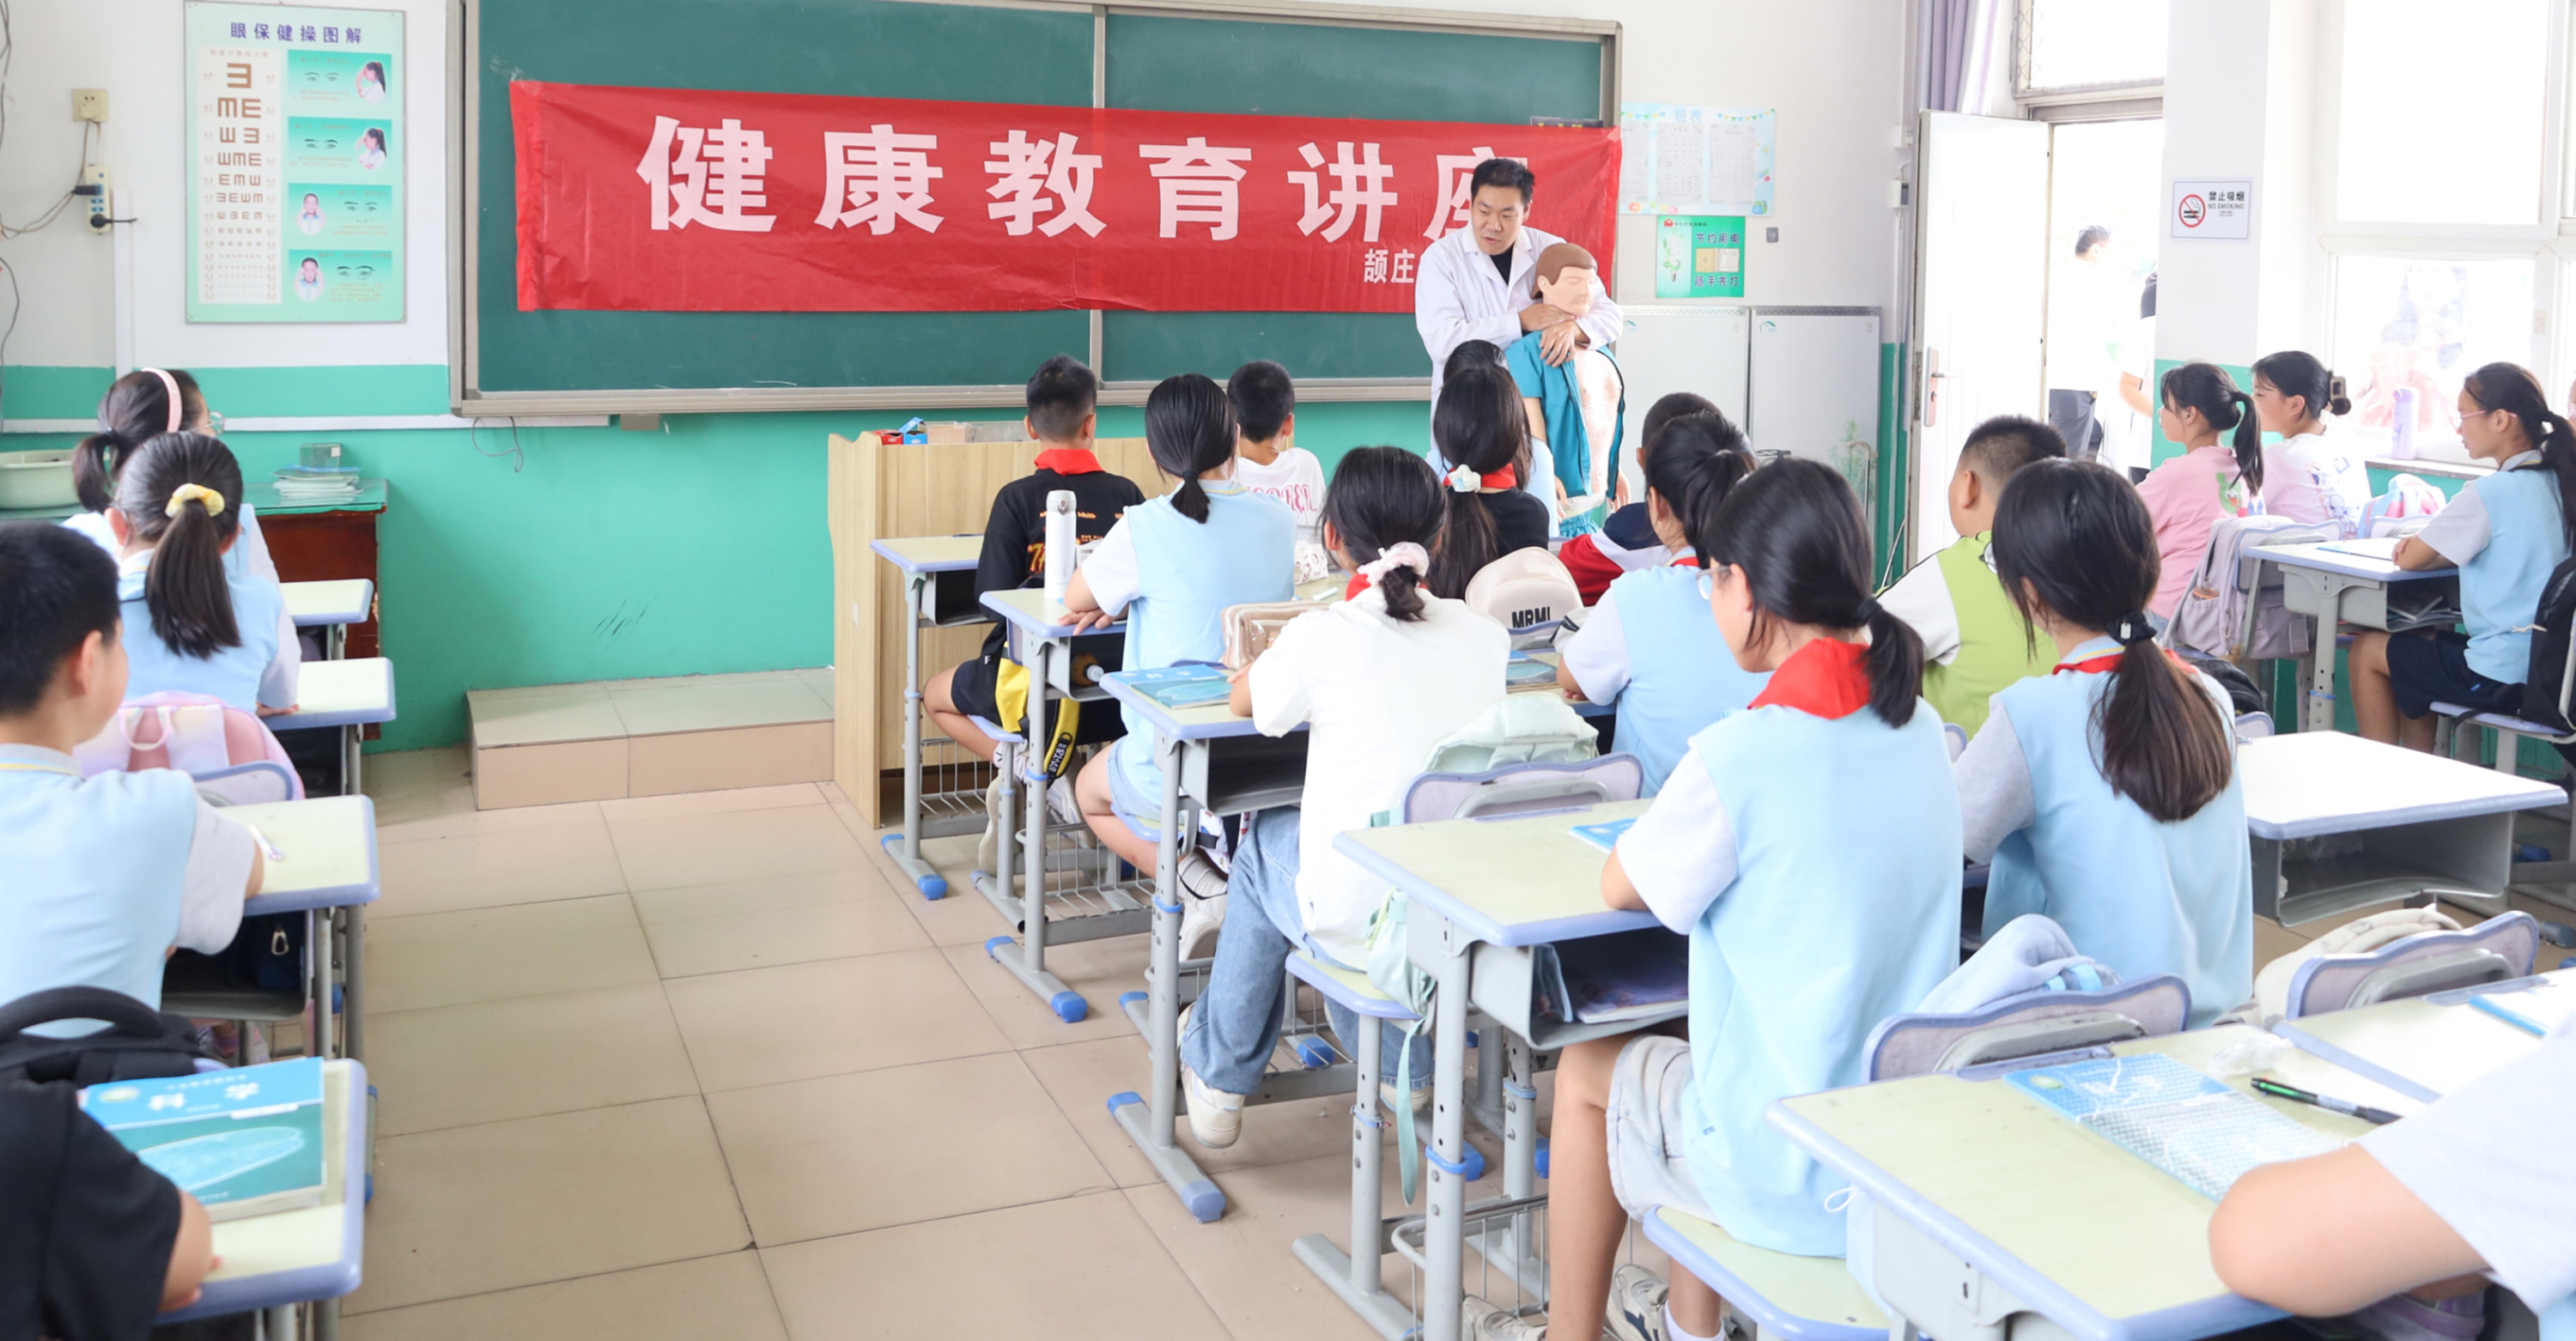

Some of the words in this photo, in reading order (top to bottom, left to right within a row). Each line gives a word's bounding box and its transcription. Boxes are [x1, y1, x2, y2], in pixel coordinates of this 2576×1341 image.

[230, 22, 362, 44] 眼保健操图解
[2208, 191, 2245, 202] 禁止吸烟
[1696, 233, 1740, 245] 节约用电
[1694, 275, 1739, 288] 随手关灯
